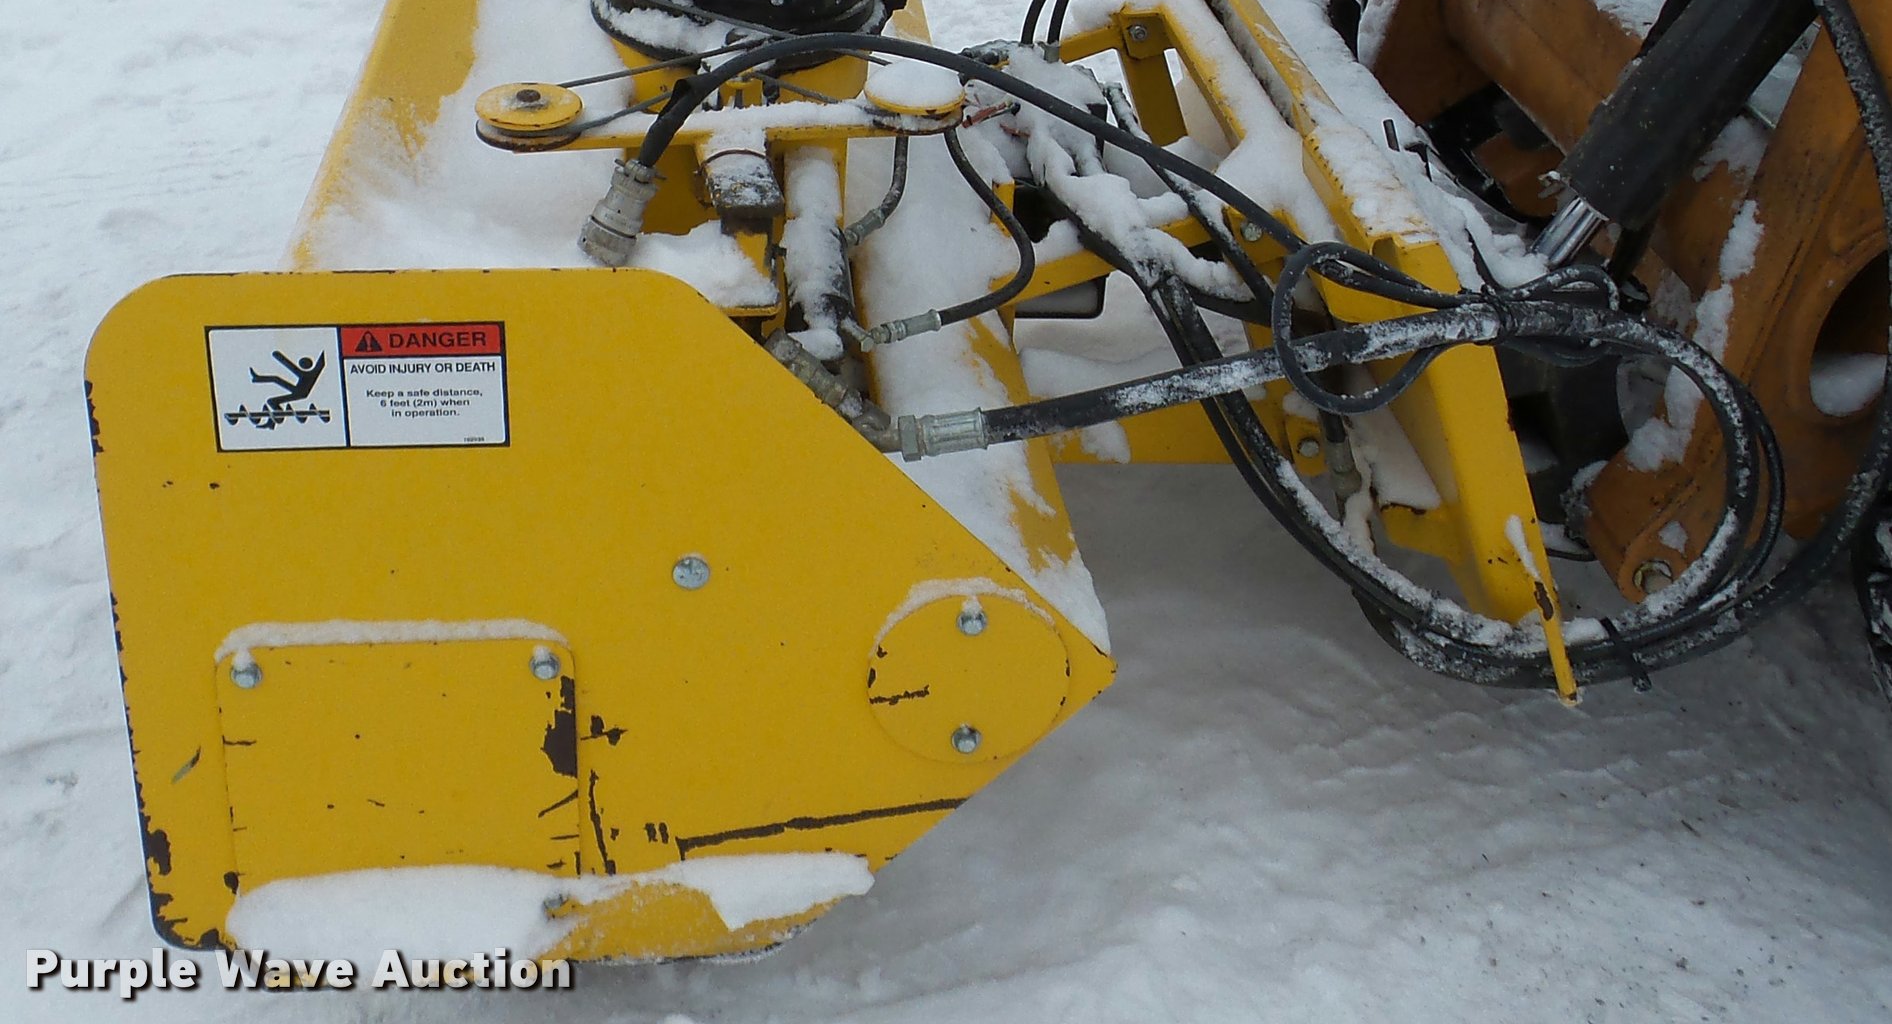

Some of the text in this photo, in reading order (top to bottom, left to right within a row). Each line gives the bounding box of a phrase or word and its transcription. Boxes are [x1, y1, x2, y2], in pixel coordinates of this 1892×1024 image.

[389, 331, 487, 349] DANGER
[350, 362, 496, 374] AVOID INJURY OR DEATH
[366, 389, 394, 398] Keep
[407, 389, 430, 397] safe
[432, 389, 483, 397] distance,
[390, 399, 410, 407] feet
[413, 399, 438, 408] (2m)
[391, 409, 460, 418] in operation.
